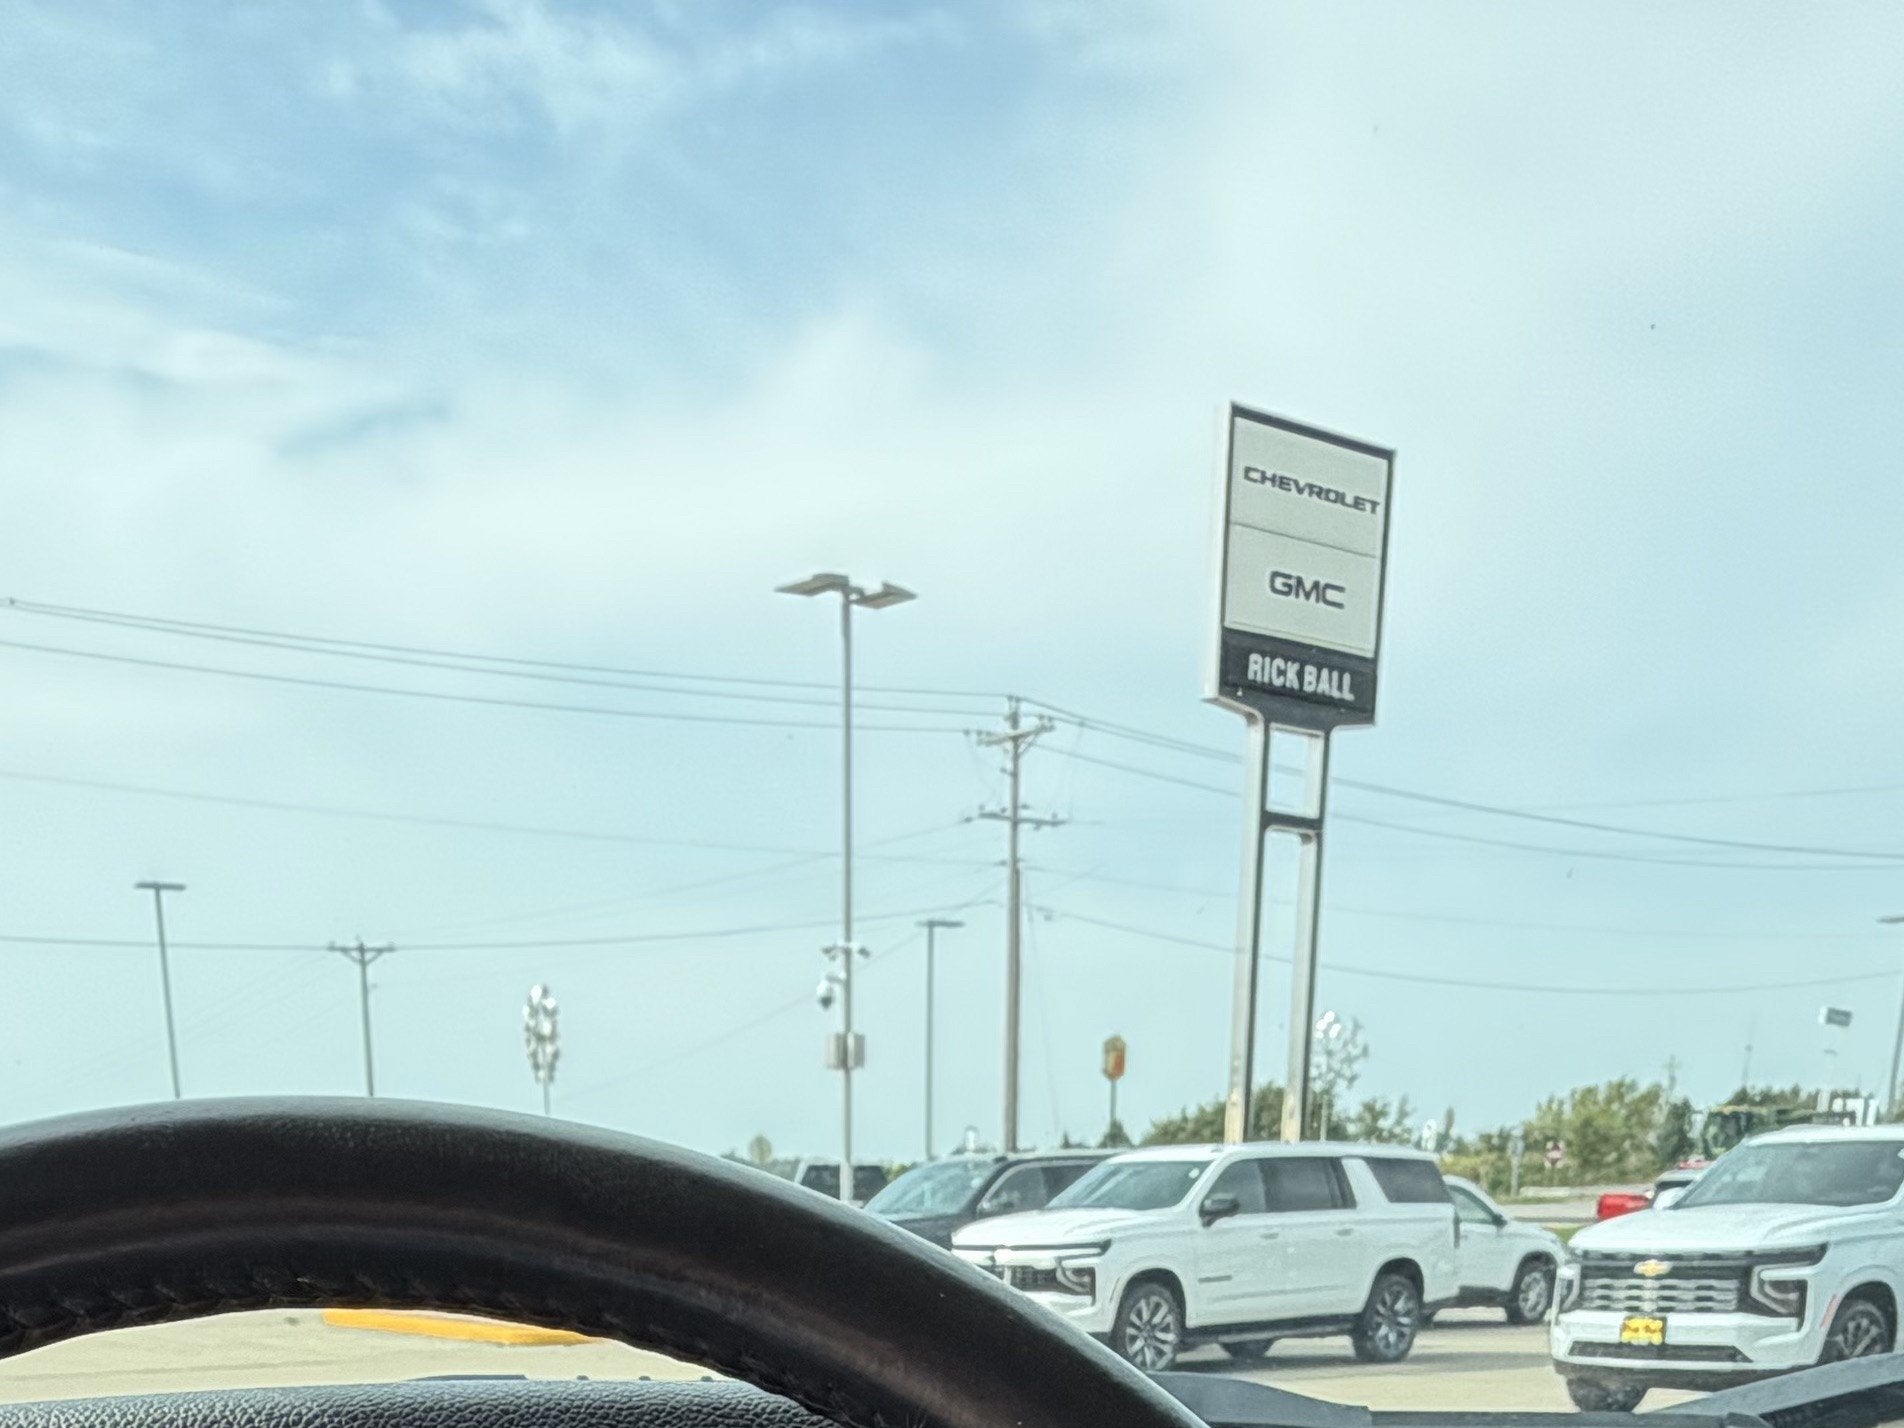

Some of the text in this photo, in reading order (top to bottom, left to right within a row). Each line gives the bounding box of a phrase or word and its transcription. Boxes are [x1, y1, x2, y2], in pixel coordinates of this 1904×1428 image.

[1243, 465, 1380, 515] CHEVROLET
[1268, 570, 1346, 610] GMC
[1247, 653, 1356, 701] RICK BALL
